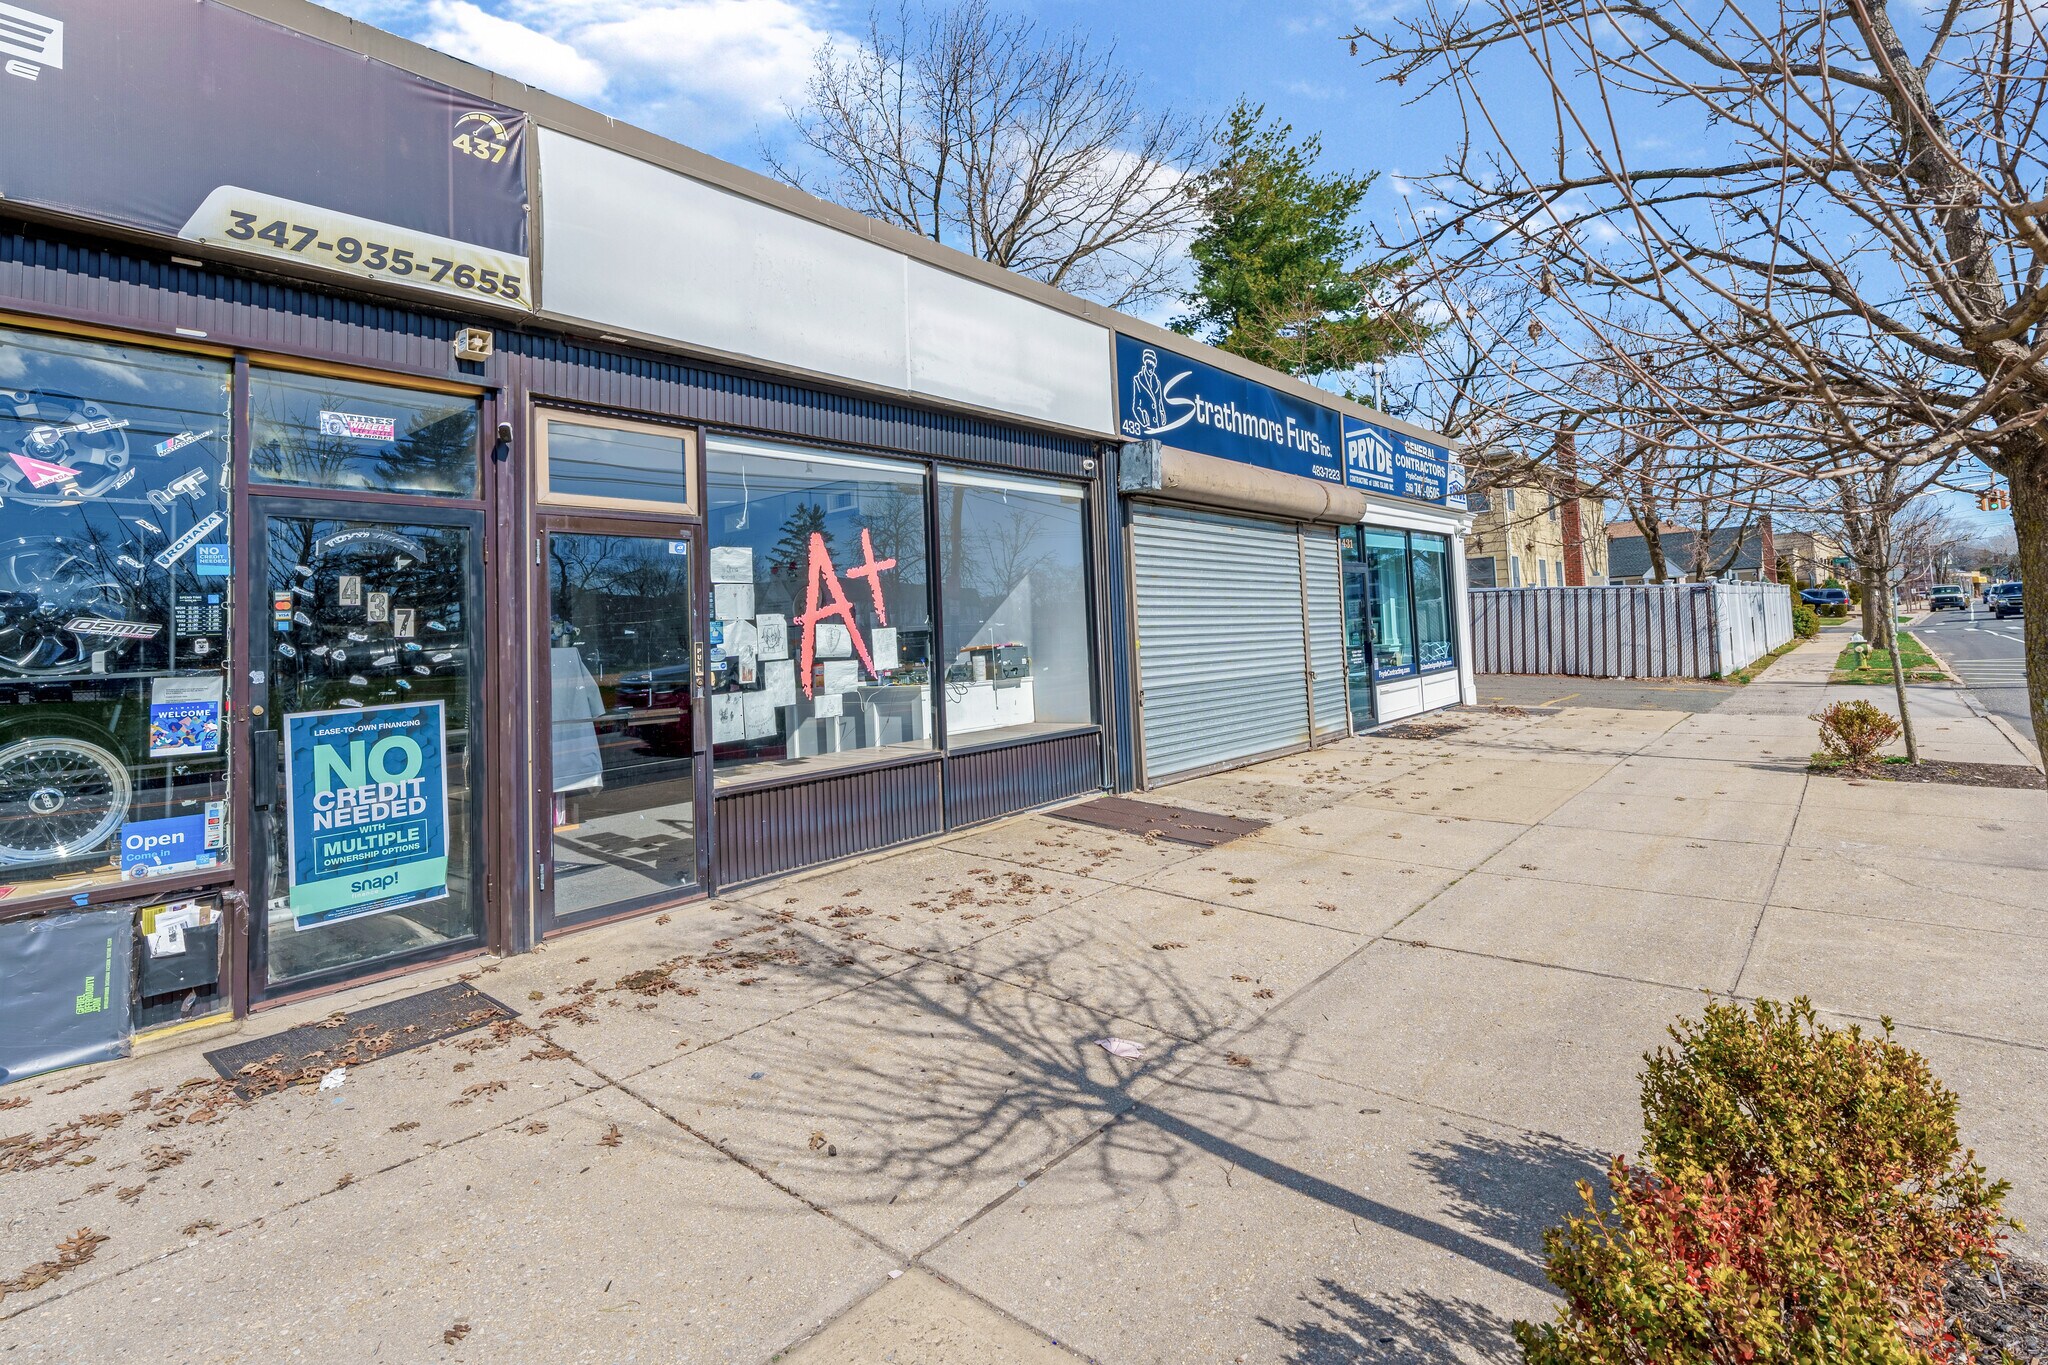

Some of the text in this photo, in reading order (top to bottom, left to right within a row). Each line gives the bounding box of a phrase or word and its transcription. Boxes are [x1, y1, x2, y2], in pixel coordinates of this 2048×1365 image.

[452, 133, 507, 164] 437
[224, 209, 522, 300] 347-935-7655
[346, 414, 393, 426] TIRES
[1143, 370, 1284, 445] Strathmore
[1286, 416, 1320, 455] Furs
[350, 422, 392, 431] WHEELS
[1122, 419, 1141, 436] 433
[1347, 436, 1394, 476] PRYDE
[1404, 440, 1436, 461] GENERAL
[1395, 453, 1446, 479] CONTRACTORS
[168, 516, 218, 559] ROHANA
[199, 546, 220, 555] NO
[157, 709, 212, 719] WELCOME
[314, 719, 421, 737] LEASE-TO-OWN FINANCING
[313, 735, 423, 796] NO
[313, 776, 426, 812] CREDIT
[313, 797, 427, 832] NEEDED
[359, 822, 386, 834] WITH
[126, 831, 185, 852] Open
[323, 827, 420, 857] MULTIPLE
[126, 849, 171, 862] Come in
[324, 842, 421, 867] OWNERSHIP OPTIONS
[351, 871, 399, 893] snap!
[351, 889, 379, 899] finance
